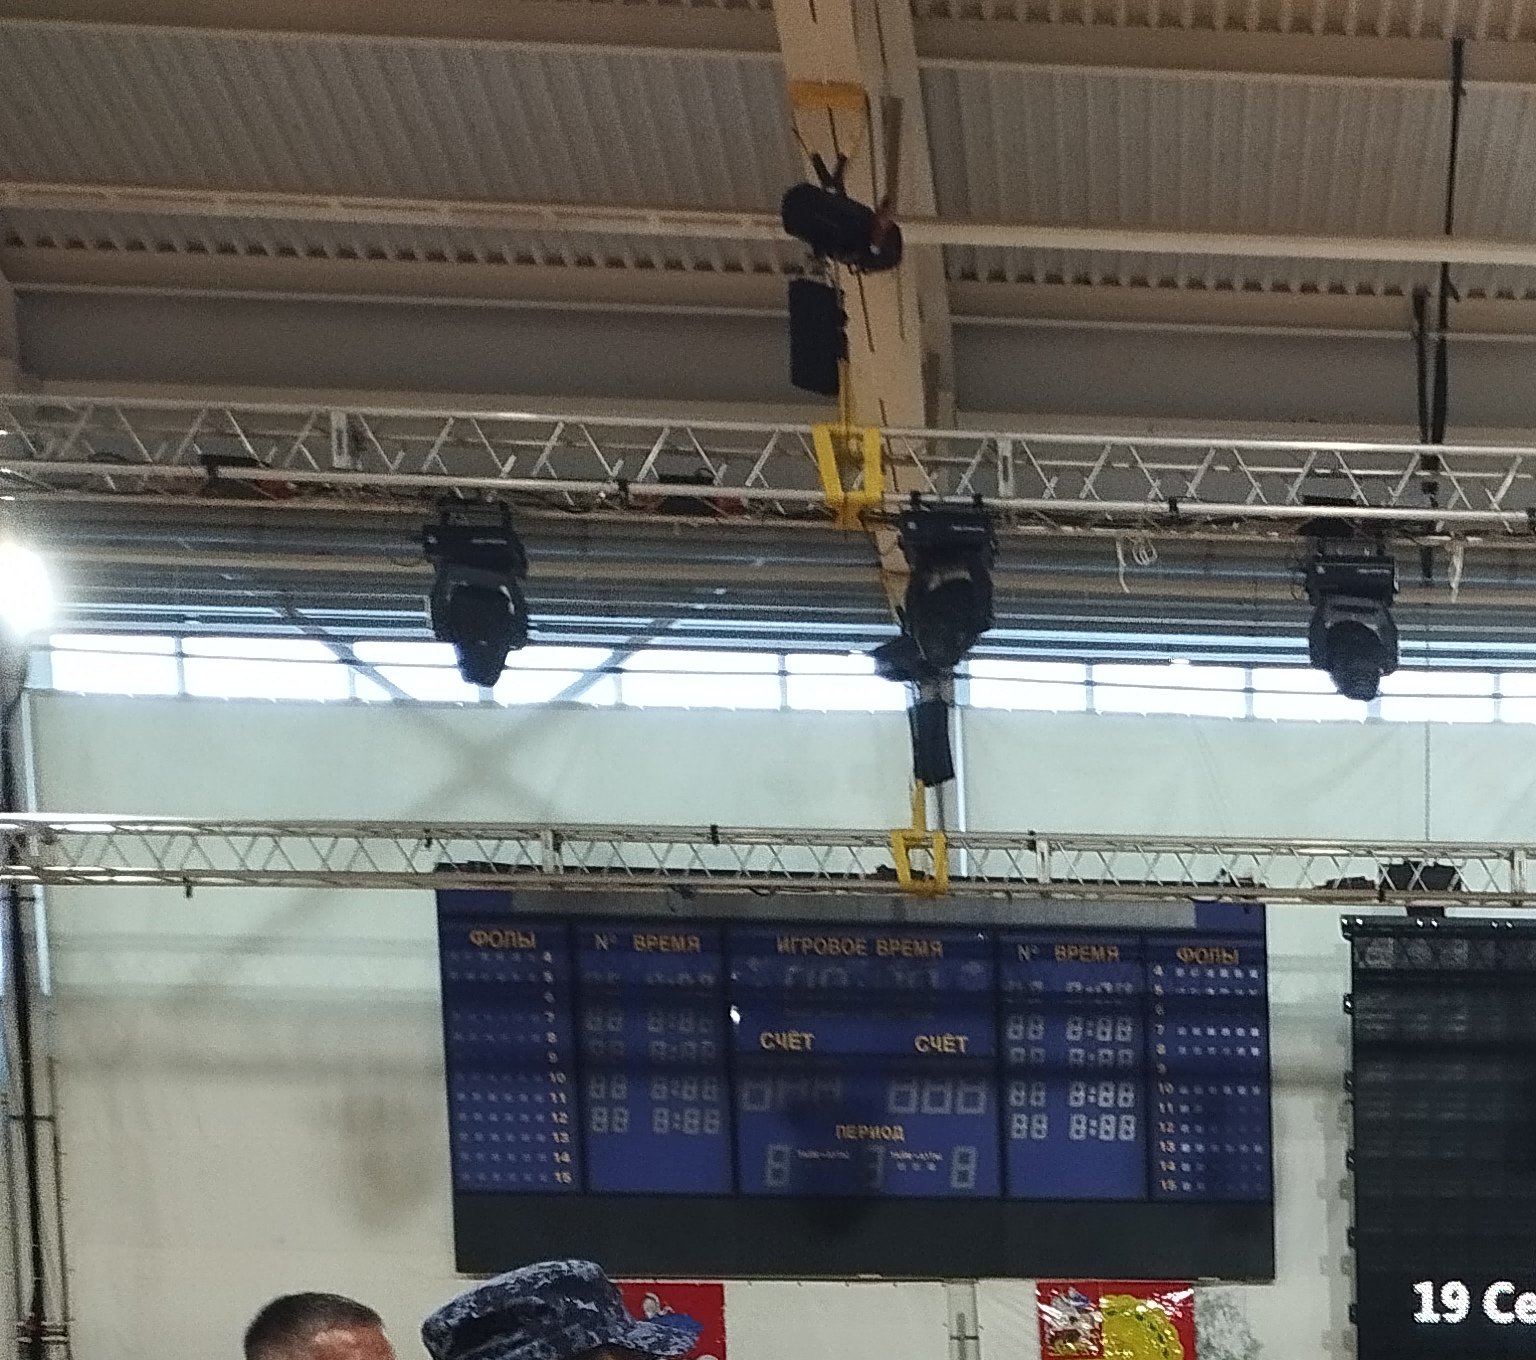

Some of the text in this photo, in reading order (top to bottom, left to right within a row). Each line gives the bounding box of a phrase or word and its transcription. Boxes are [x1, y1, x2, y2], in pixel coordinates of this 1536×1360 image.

[469, 930, 536, 949] ФОЛЫ
[633, 933, 701, 952] ВРЕМЯ
[776, 936, 944, 958] ИГРОВОЕ ВРЕМЯ
[1054, 944, 1119, 963] ВРЕМЯ
[1176, 945, 1240, 966] ФОЛЫ
[550, 1071, 567, 1084] 10
[550, 1091, 567, 1104] 11
[1158, 1081, 1174, 1095] 10
[1159, 1101, 1174, 1115] 11
[836, 1124, 905, 1141] ПЕРИОД
[1412, 1280, 1471, 1325] 19
